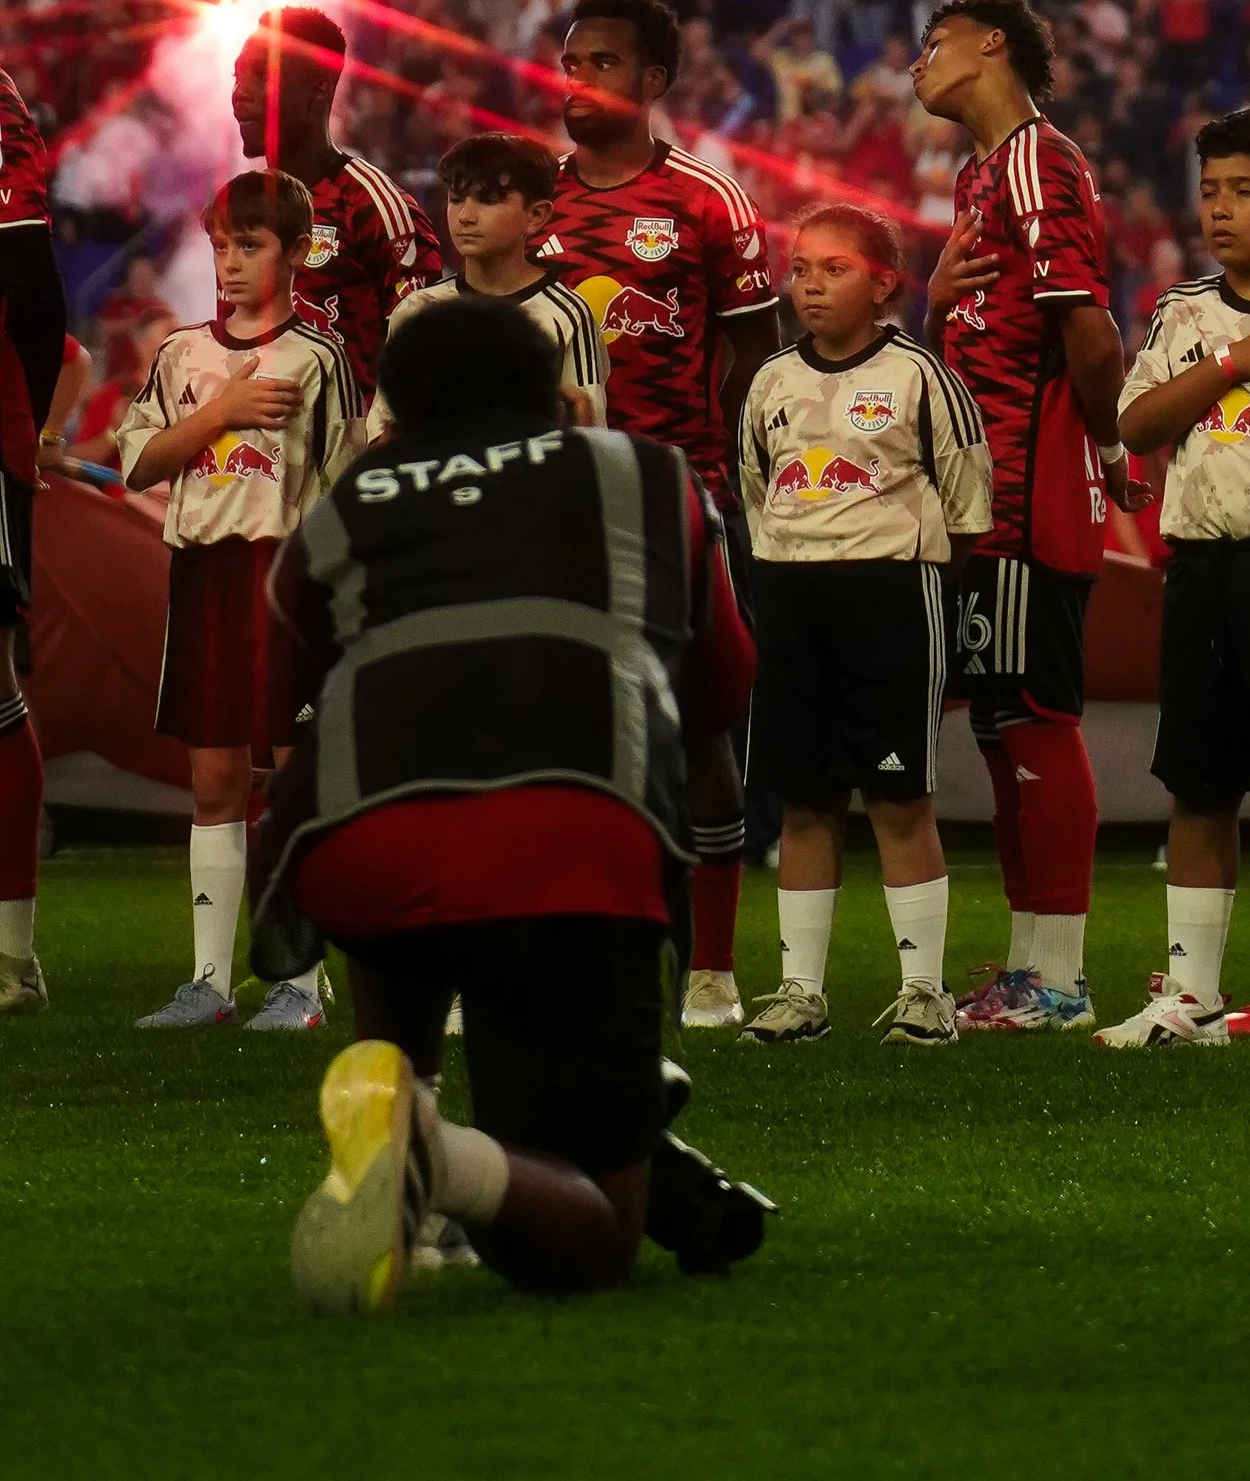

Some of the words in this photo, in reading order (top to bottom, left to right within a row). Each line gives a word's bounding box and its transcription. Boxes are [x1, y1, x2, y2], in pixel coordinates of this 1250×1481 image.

[0, 188, 12, 205] v
[638, 222, 670, 231] RedBull
[753, 269, 770, 288] tv
[355, 429, 563, 504] STAFF
